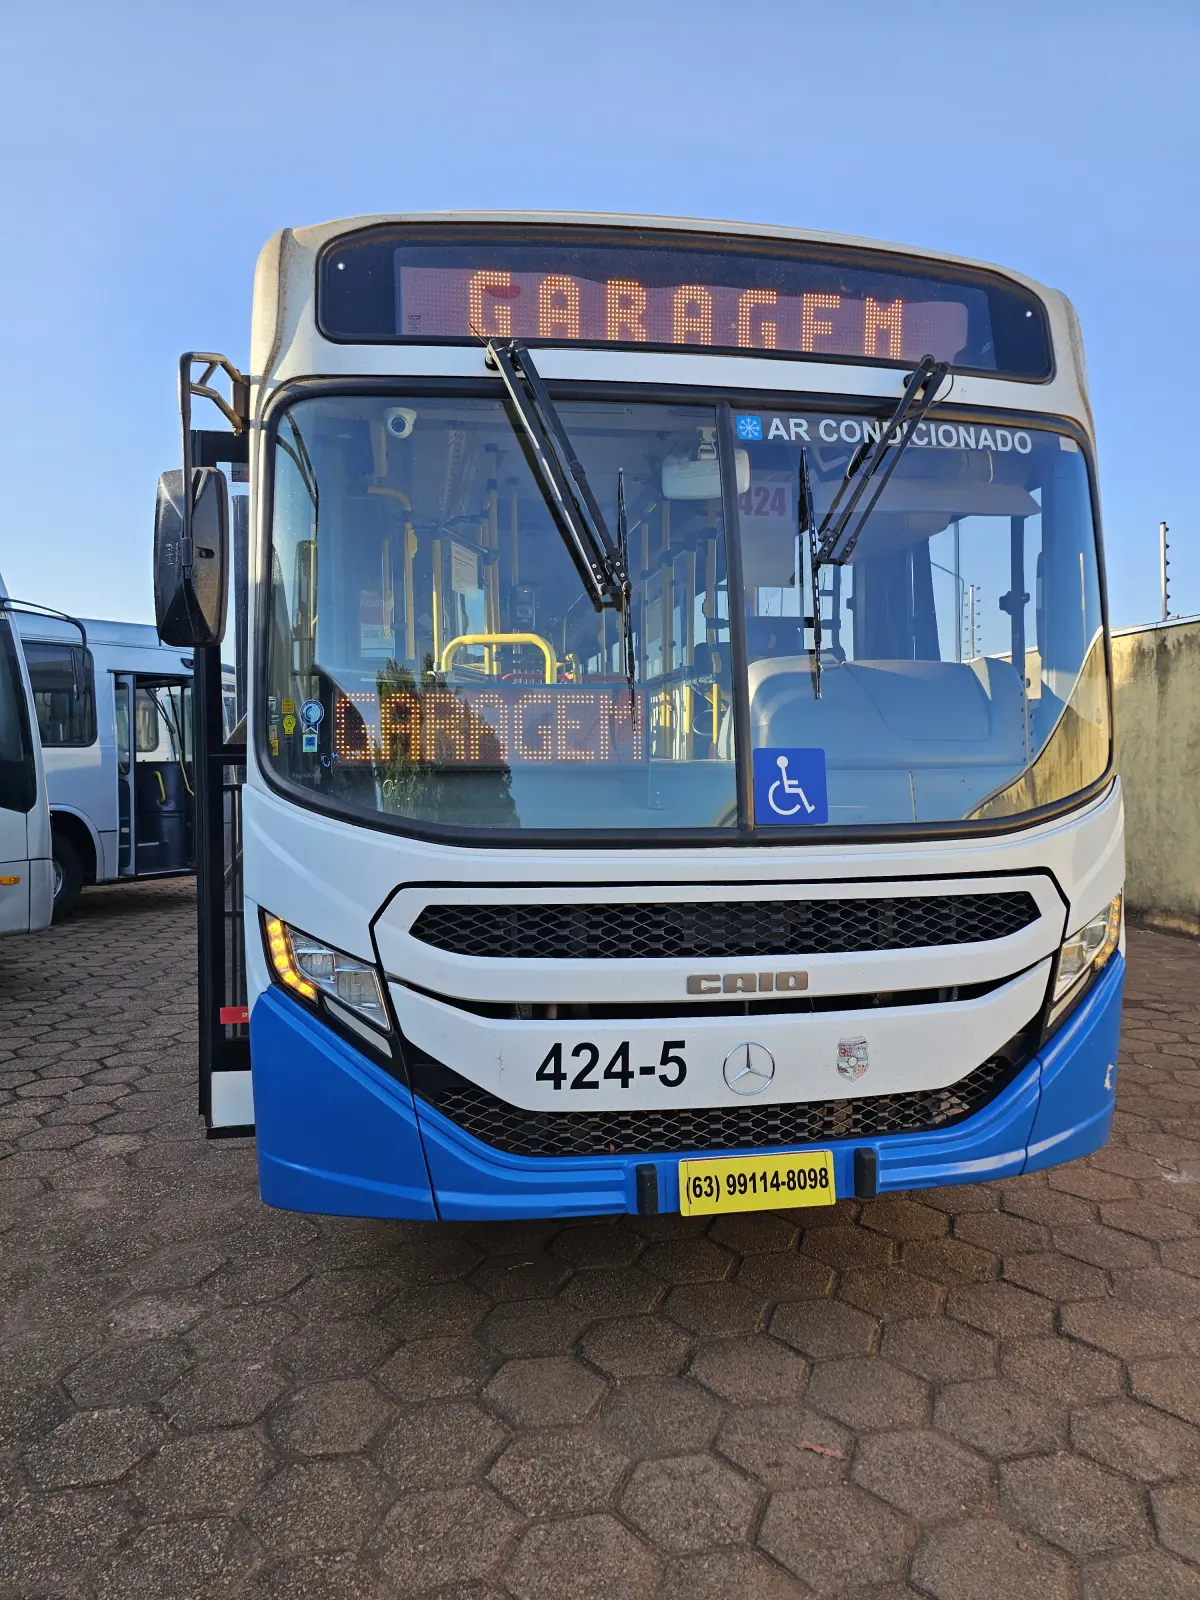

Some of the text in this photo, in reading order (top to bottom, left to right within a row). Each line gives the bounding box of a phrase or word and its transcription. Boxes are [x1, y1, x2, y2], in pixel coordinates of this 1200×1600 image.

[767, 417, 1032, 454] AR CONDICIONADO
[739, 486, 788, 516] 424
[336, 693, 643, 760] GARAGEM
[687, 971, 809, 995] CAIO
[536, 1040, 687, 1090] 424-5
[686, 1167, 829, 1205] (63) 99114-8098
